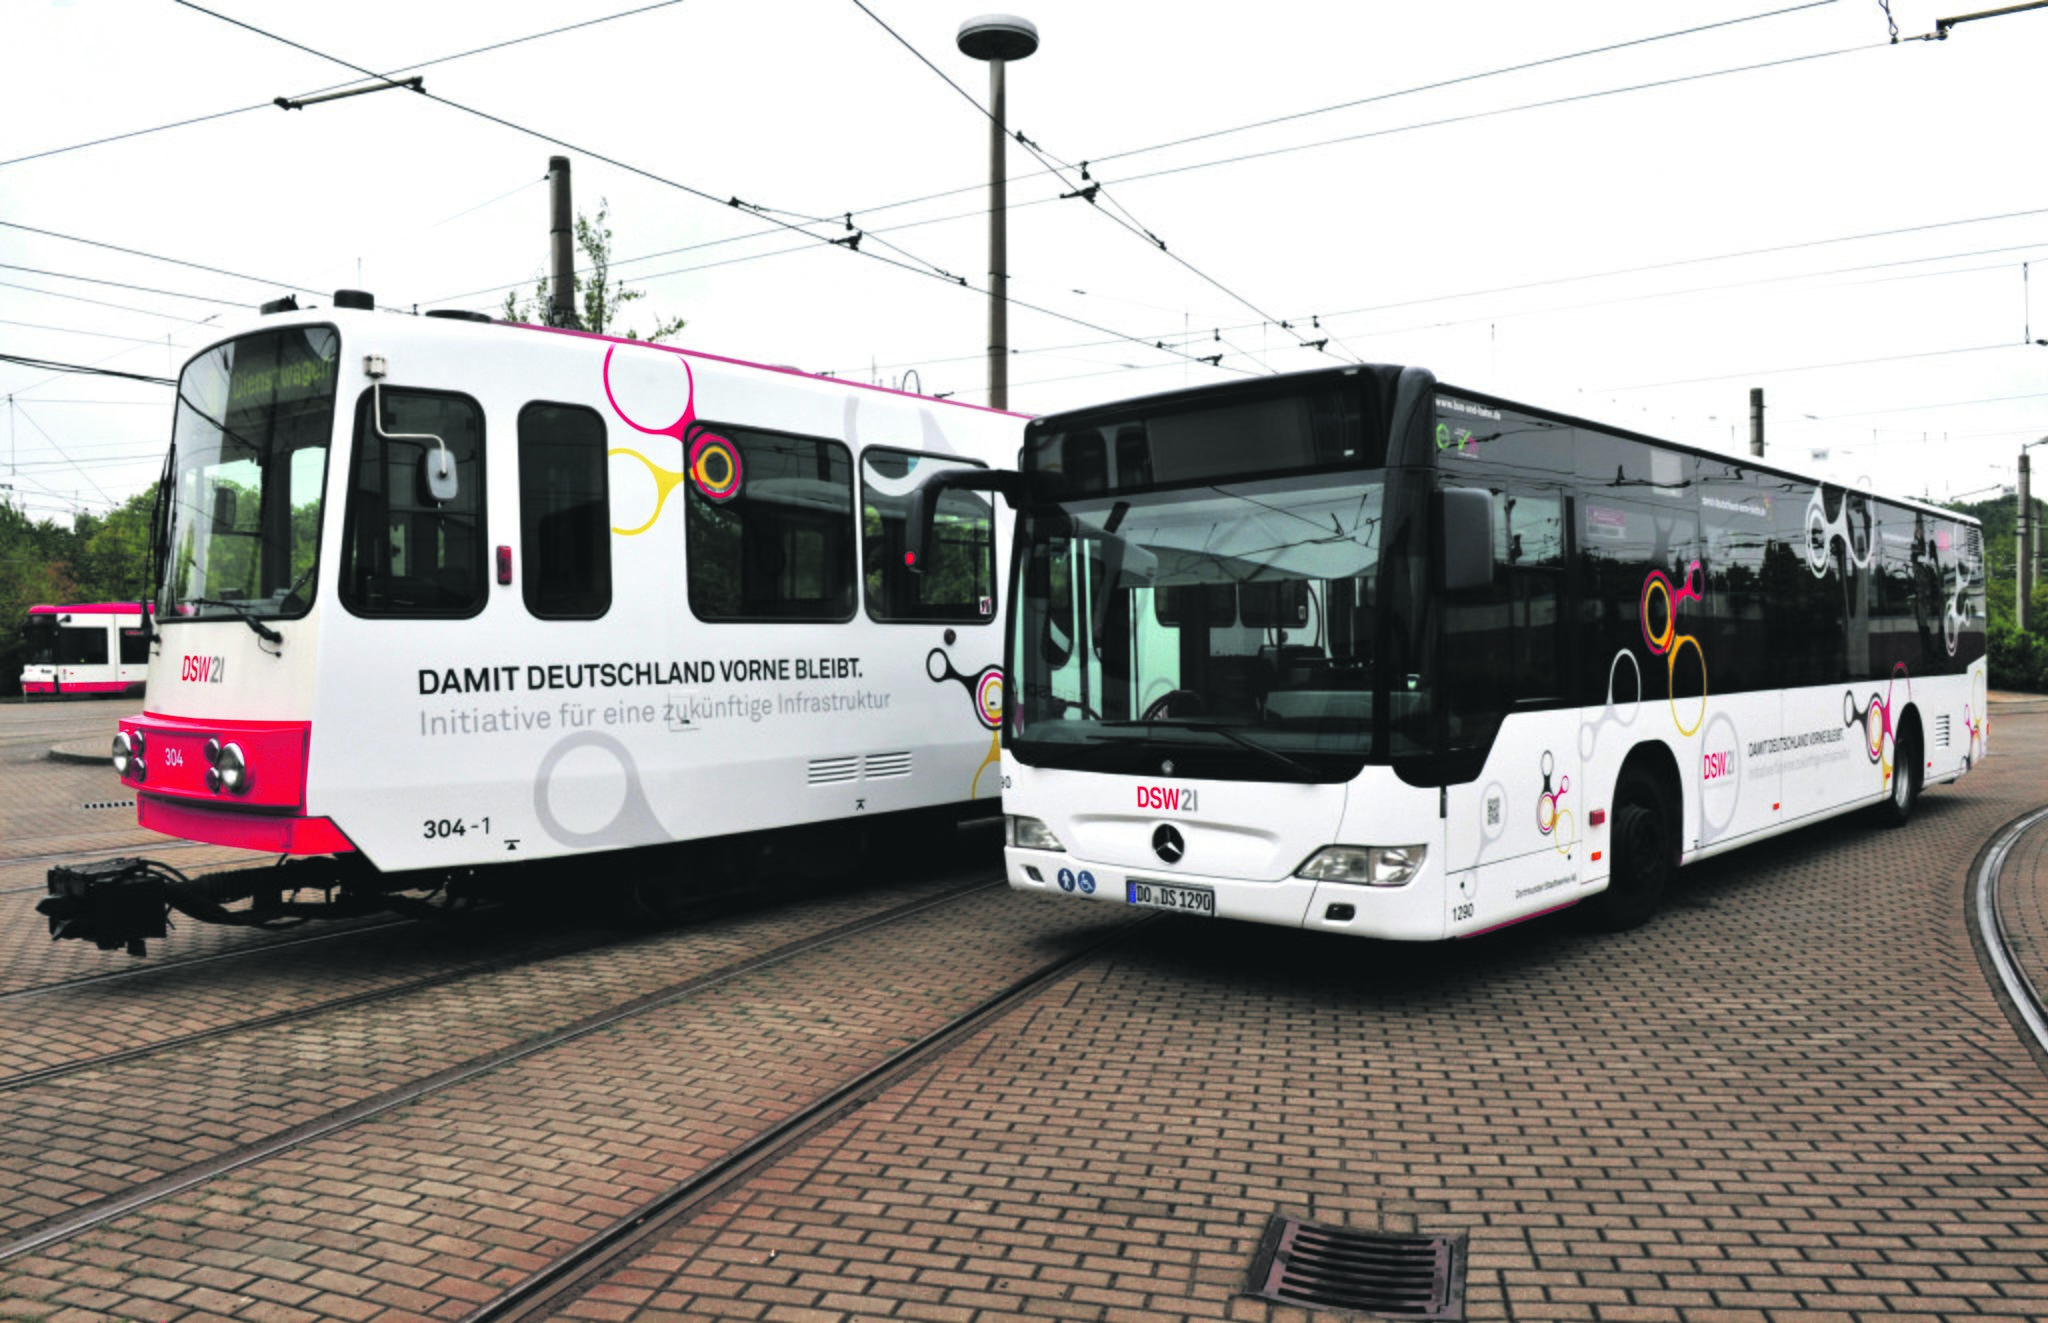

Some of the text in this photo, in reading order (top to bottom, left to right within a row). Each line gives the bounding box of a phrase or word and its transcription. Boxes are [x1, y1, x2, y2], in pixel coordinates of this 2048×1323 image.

[181, 655, 225, 683] DSW21
[418, 657, 863, 695] DAMIT DEUTSCHLAND VORNE BLEIBT.
[420, 690, 891, 736] Initiative für eine zukünftige Infrastruktur
[165, 747, 184, 767] 304
[1703, 750, 1735, 780] DSW21
[1137, 786, 1199, 812] DSW21
[1136, 885, 1211, 910] DO DS 1290
[1453, 902, 1474, 922] 1290
